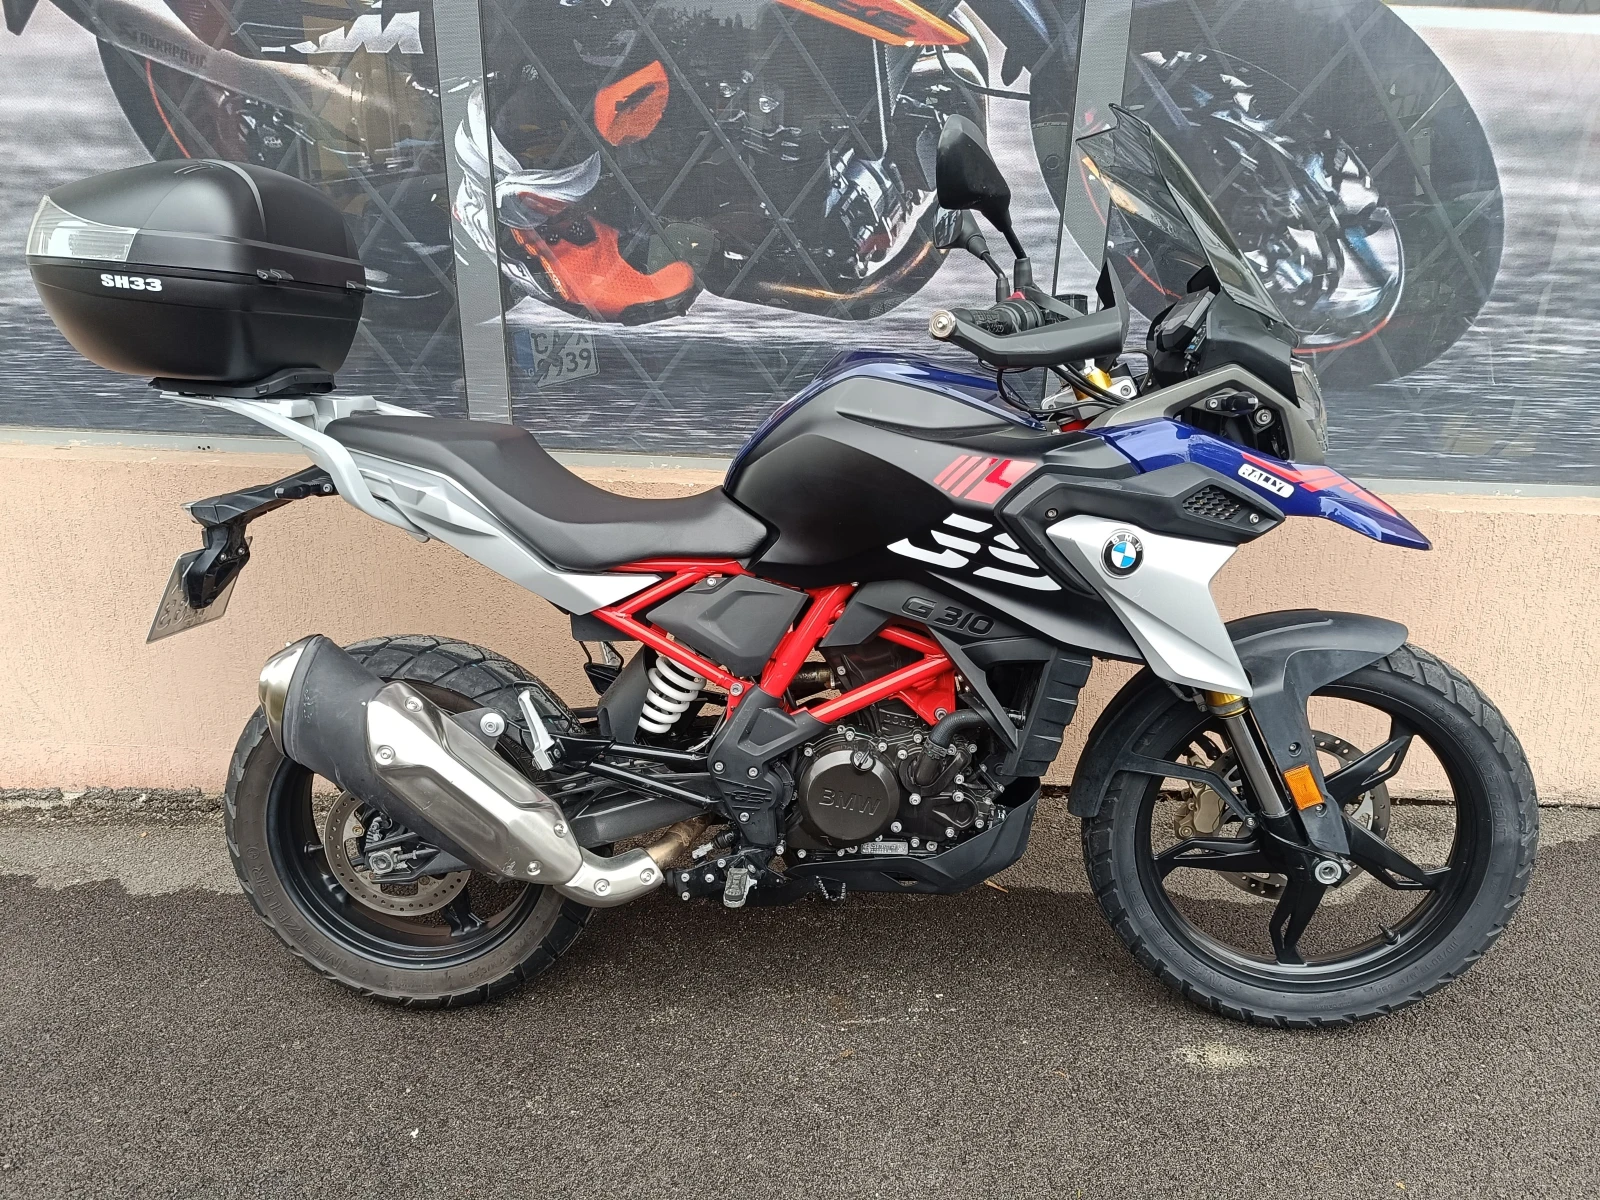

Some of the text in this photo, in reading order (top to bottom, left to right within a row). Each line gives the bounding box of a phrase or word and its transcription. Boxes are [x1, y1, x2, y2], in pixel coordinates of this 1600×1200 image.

[100, 273, 163, 292] SH33
[1240, 465, 1290, 496] RALLY
[1111, 534, 1143, 552] BMW
[901, 596, 995, 636] G 310
[818, 787, 882, 816] BMW
[250, 866, 345, 970] METZELER
